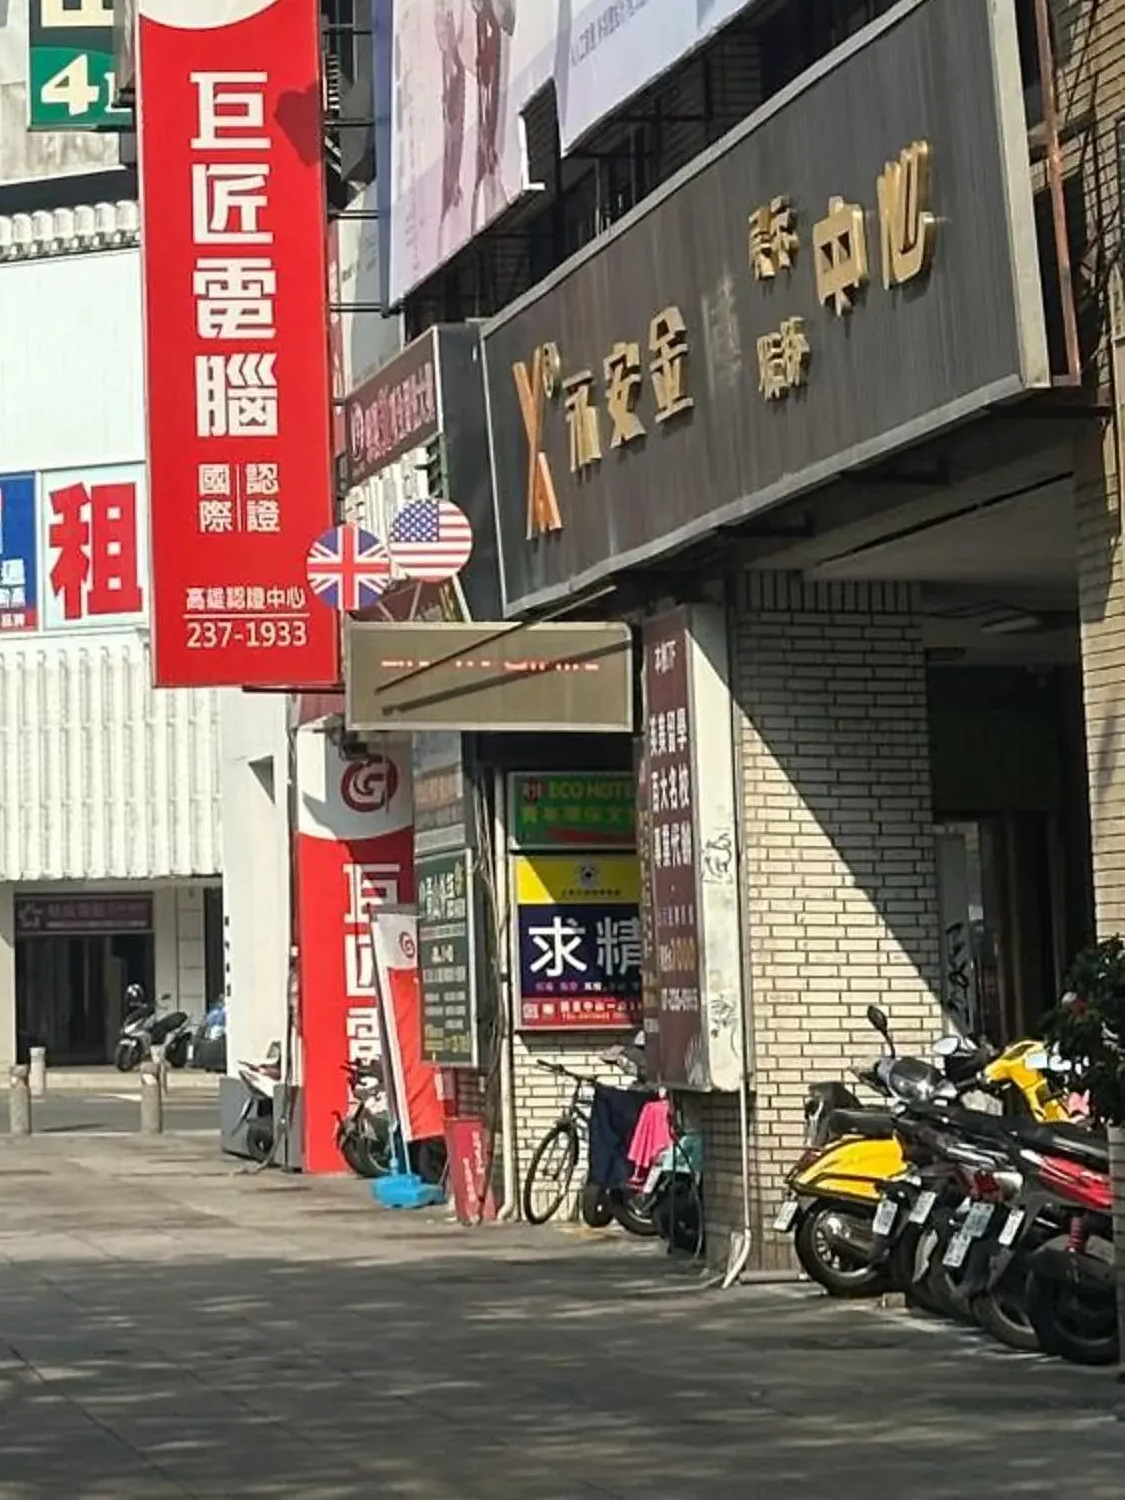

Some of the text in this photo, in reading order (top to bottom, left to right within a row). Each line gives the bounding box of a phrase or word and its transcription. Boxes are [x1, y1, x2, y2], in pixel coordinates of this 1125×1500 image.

[188, 70, 280, 437] 巨匠電腦
[198, 463, 234, 533] 國際
[245, 462, 281, 533] 認證
[48, 481, 143, 621] 租
[185, 584, 307, 611] 高雄認證中心
[186, 619, 308, 650] 237-1933
